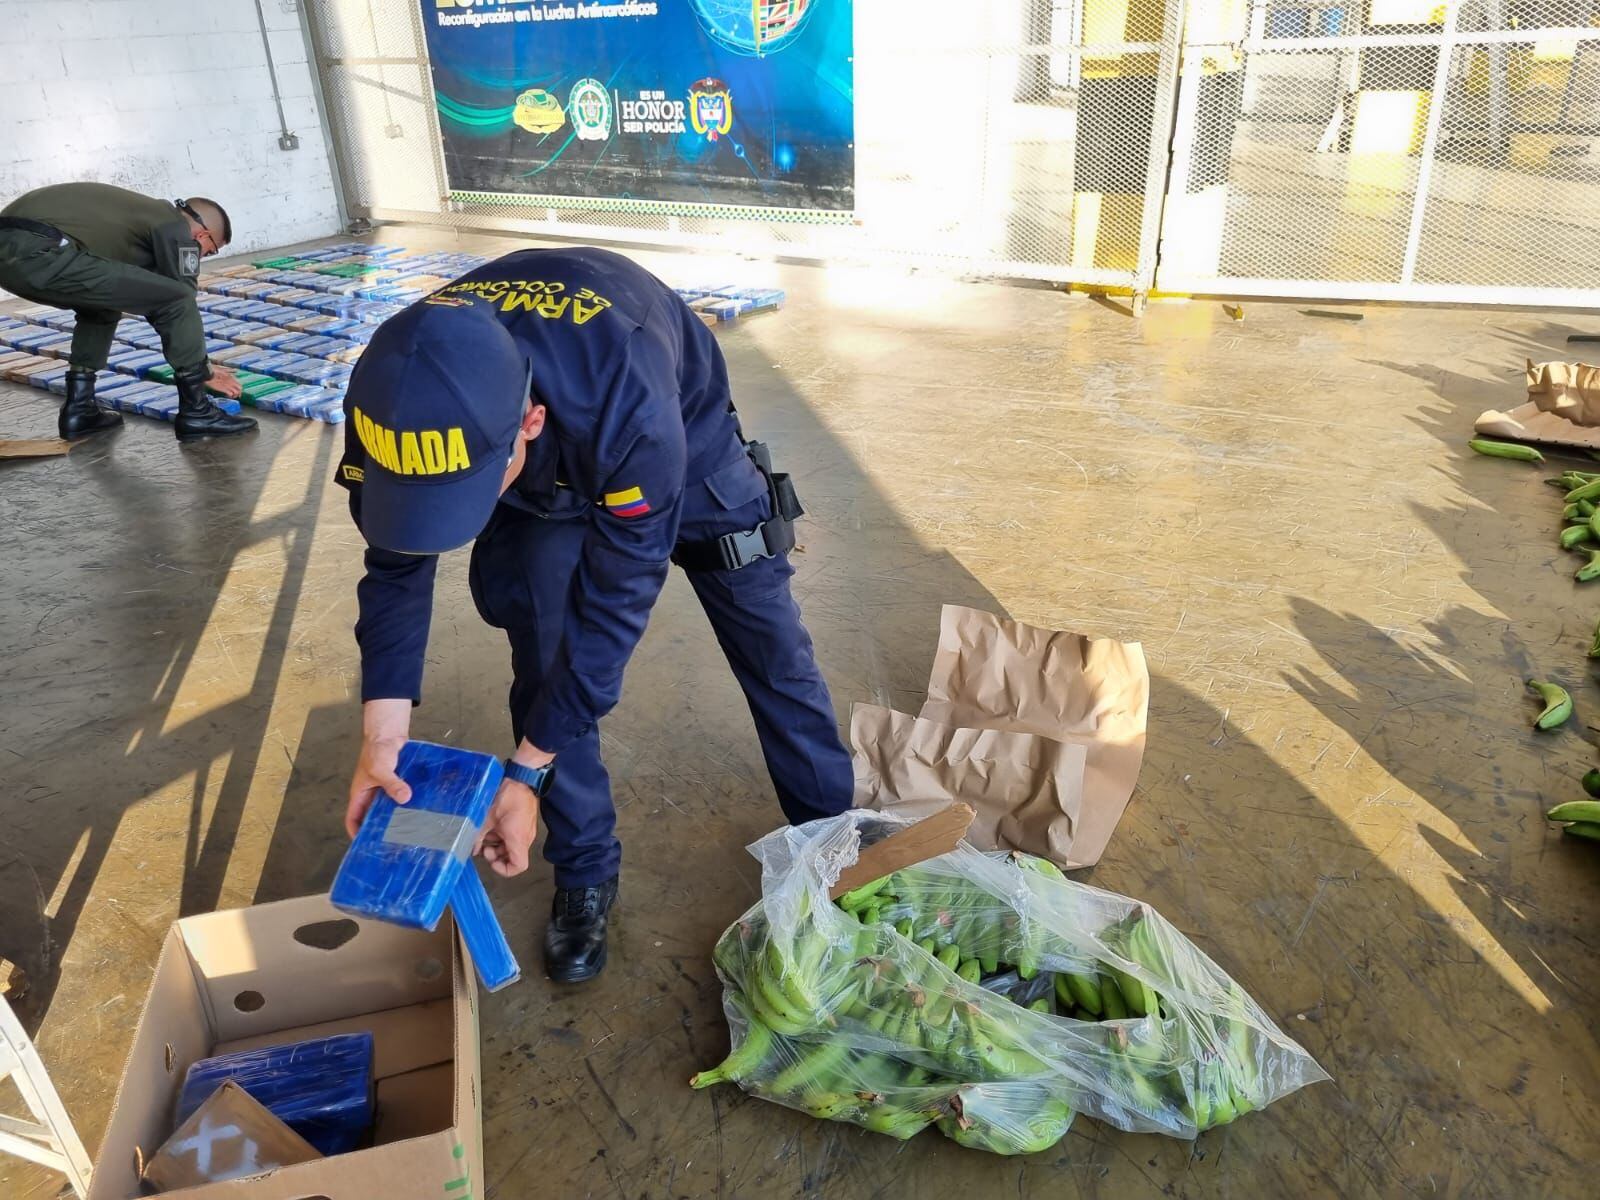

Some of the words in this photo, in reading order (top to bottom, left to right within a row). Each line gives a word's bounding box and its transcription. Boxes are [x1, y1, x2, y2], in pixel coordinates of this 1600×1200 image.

[437, 7, 514, 28] Reconfiguración
[514, 10, 531, 22] en
[531, 5, 543, 21] la
[543, 3, 576, 21] Lucha
[577, 0, 658, 19] Antinarcóticos
[639, 90, 651, 101] ES
[651, 90, 665, 101] UN
[621, 100, 686, 120] HONOR
[623, 121, 644, 133] SER
[644, 119, 686, 133] POLICÍA
[574, 287, 613, 308] DE
[353, 405, 471, 475] ARMADA
